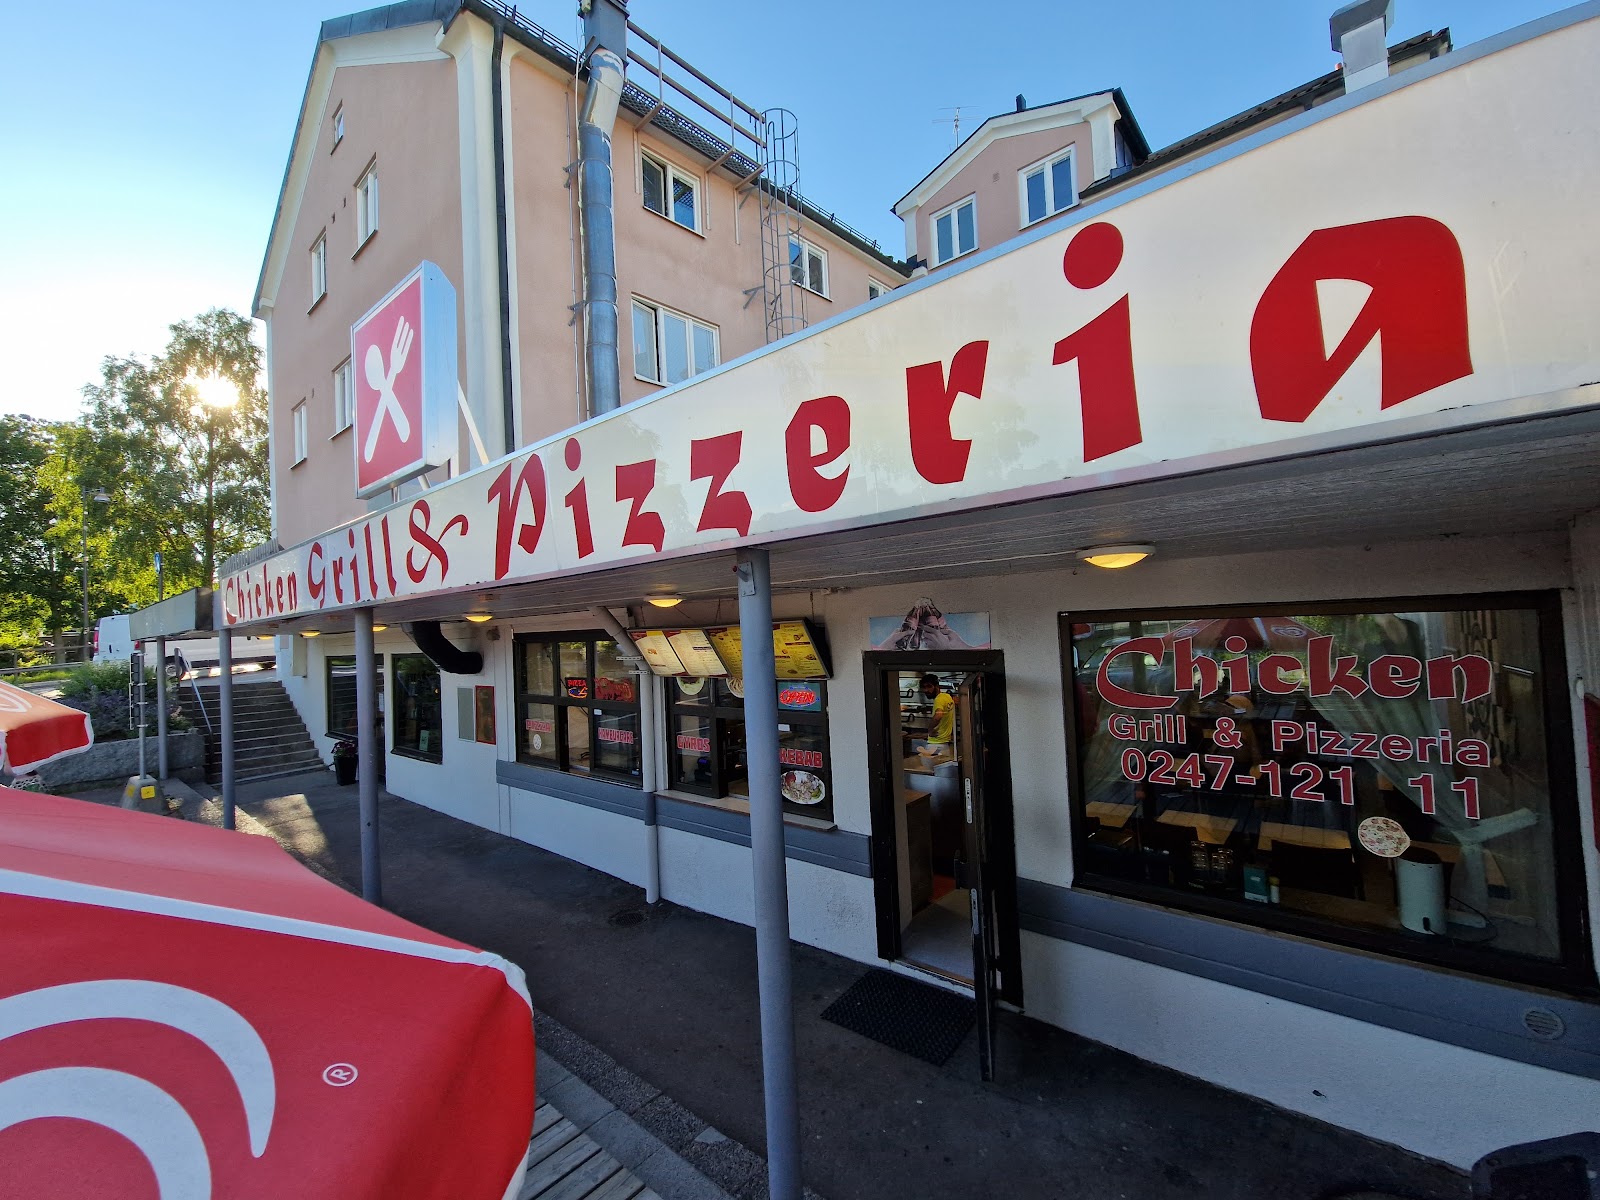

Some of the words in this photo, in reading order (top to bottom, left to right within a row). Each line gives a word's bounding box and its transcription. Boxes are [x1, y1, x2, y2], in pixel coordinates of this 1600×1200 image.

[225, 564, 298, 624] Chicken
[307, 515, 397, 608] Grill
[406, 499, 468, 584] &
[487, 215, 1474, 580] Pizzeria
[1096, 635, 1492, 709] Chicken
[779, 688, 816, 705] OPEN
[526, 719, 551, 733] PIZZA
[676, 735, 711, 752] GYROS
[1107, 713, 1187, 745] Grill
[1213, 716, 1243, 748] &
[1271, 719, 1490, 768] Pizzeria
[779, 749, 823, 769] KEBAB
[1120, 747, 1355, 806] 0247-121
